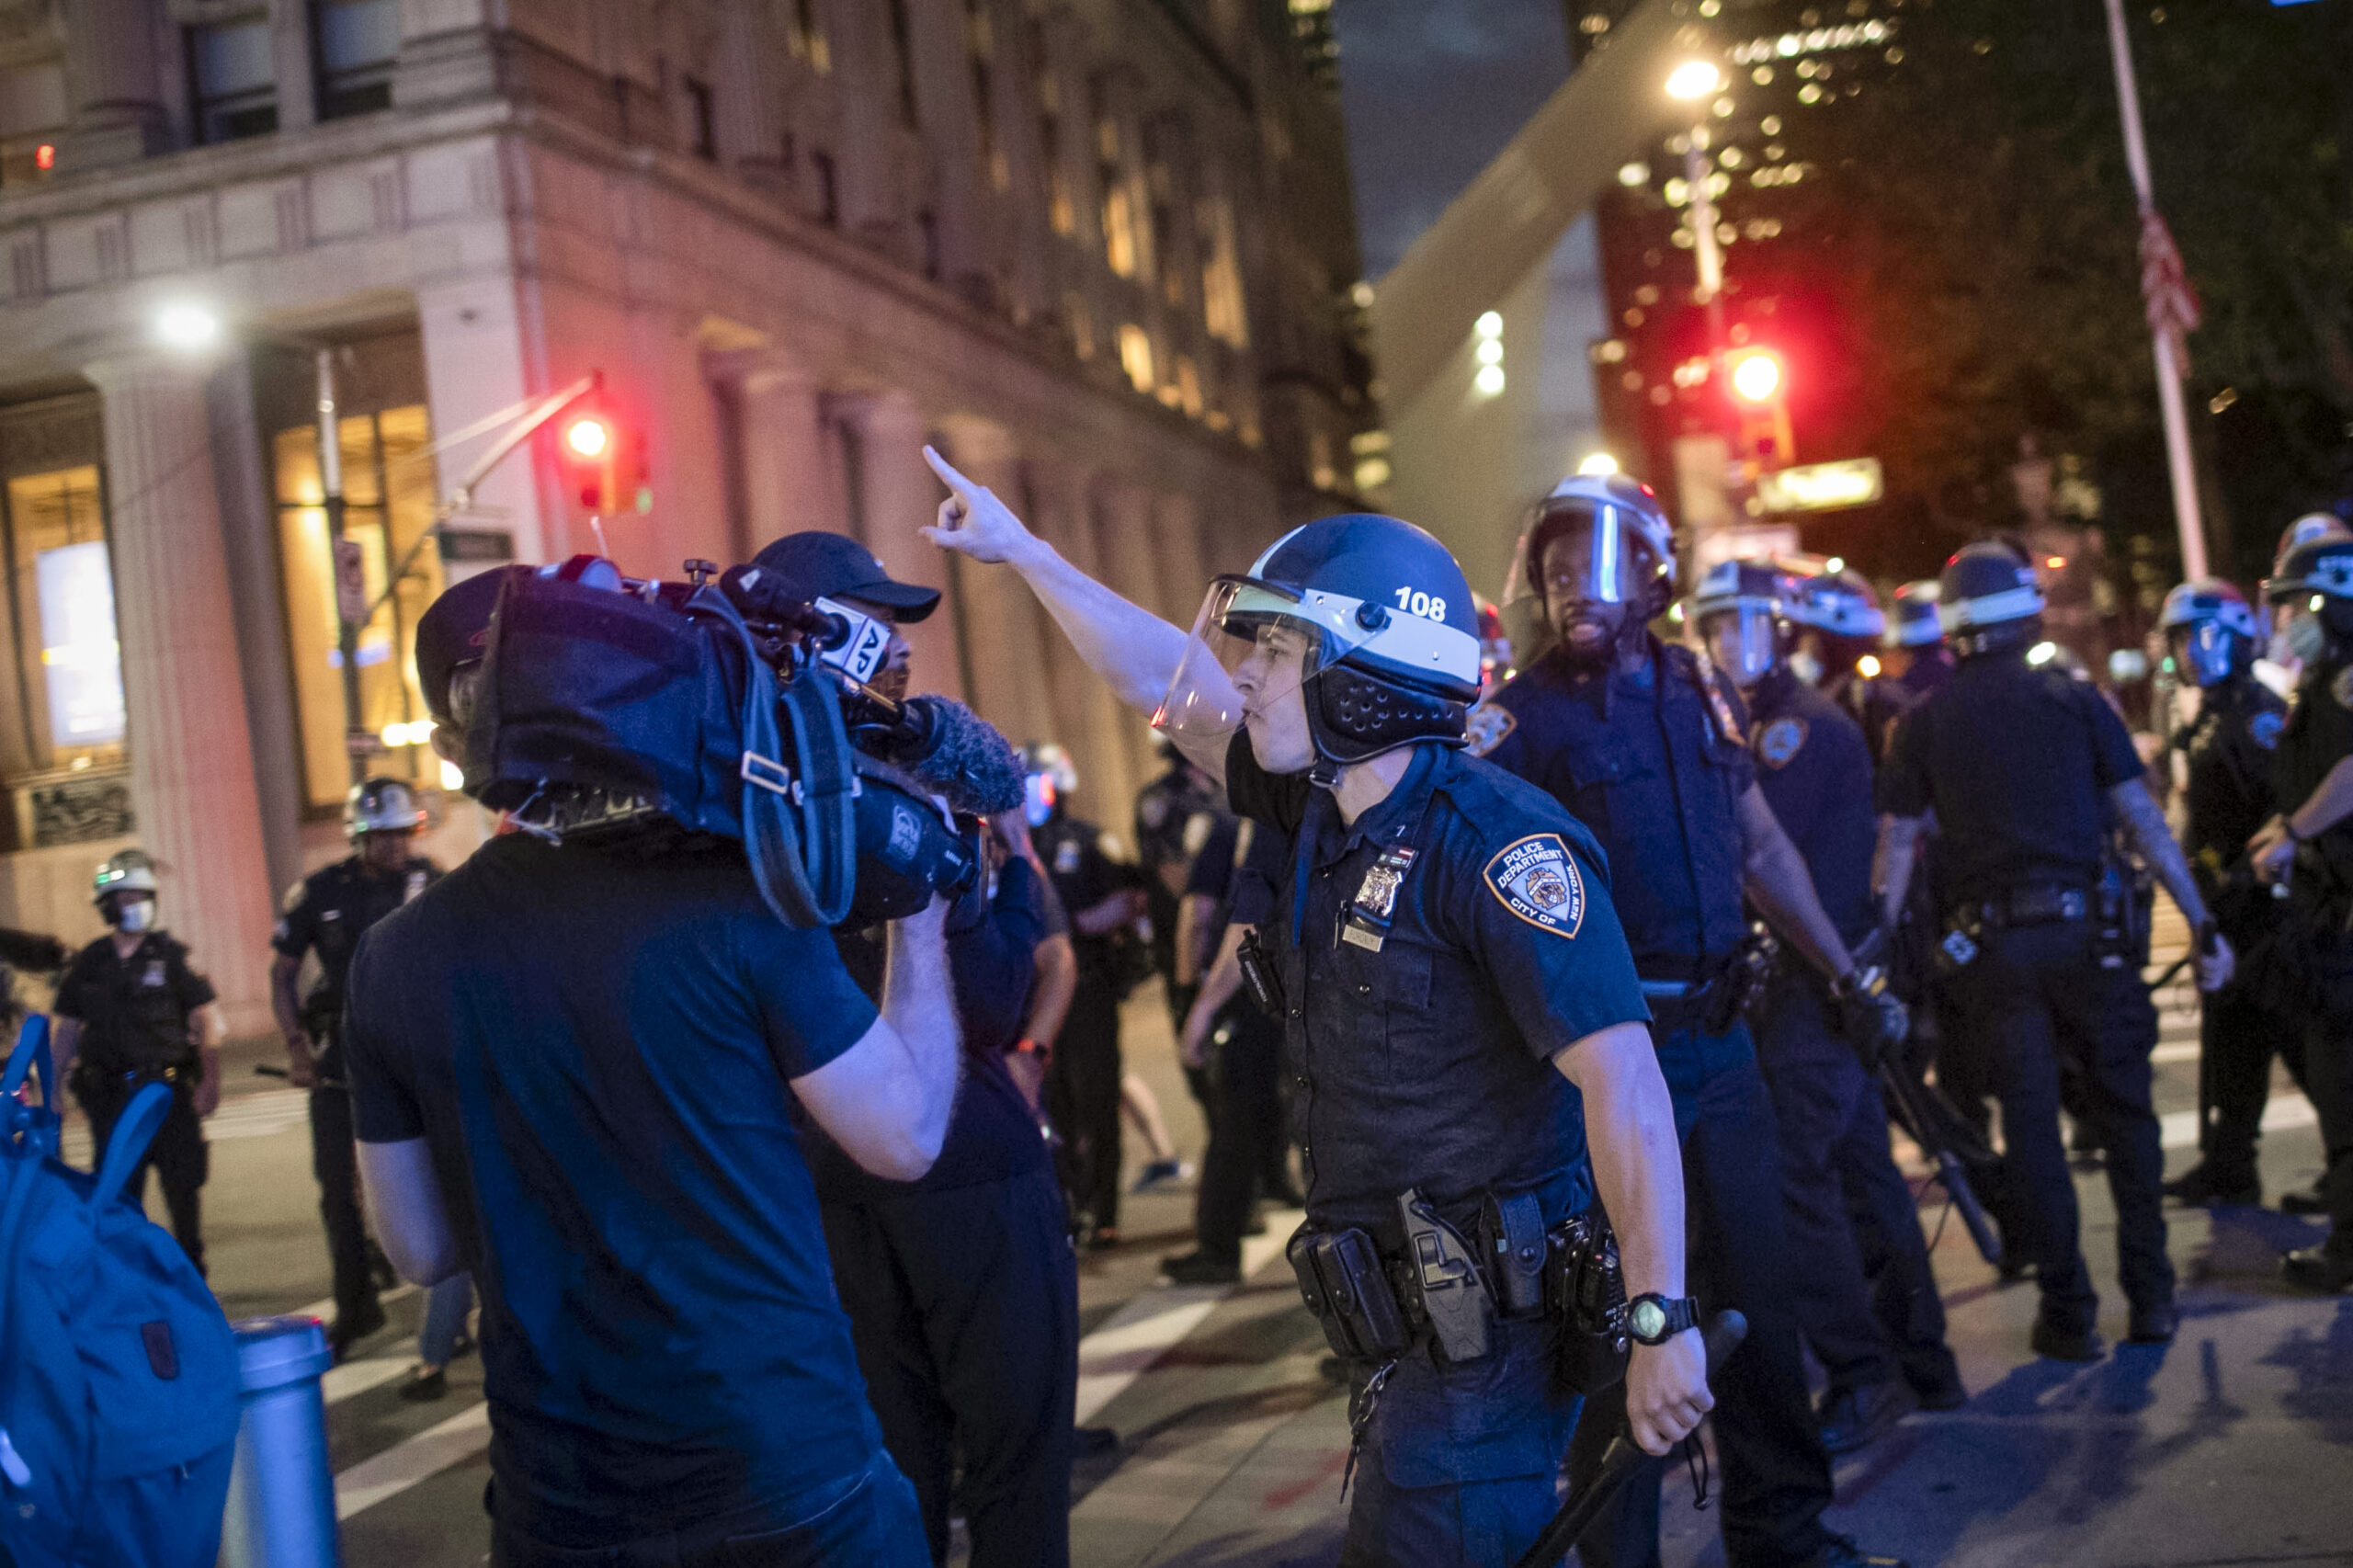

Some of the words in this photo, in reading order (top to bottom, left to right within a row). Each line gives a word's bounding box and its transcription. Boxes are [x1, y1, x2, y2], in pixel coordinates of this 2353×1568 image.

[1395, 585, 1446, 622] 108
[857, 627, 880, 675] AP
[1497, 849, 1563, 889] DEPARTMENT
[1503, 841, 1544, 867] POLICE
[1565, 864, 1579, 895] YORK
[1510, 897, 1538, 917] CITY
[1538, 914, 1557, 926] OF
[1569, 896, 1580, 922] NEW
